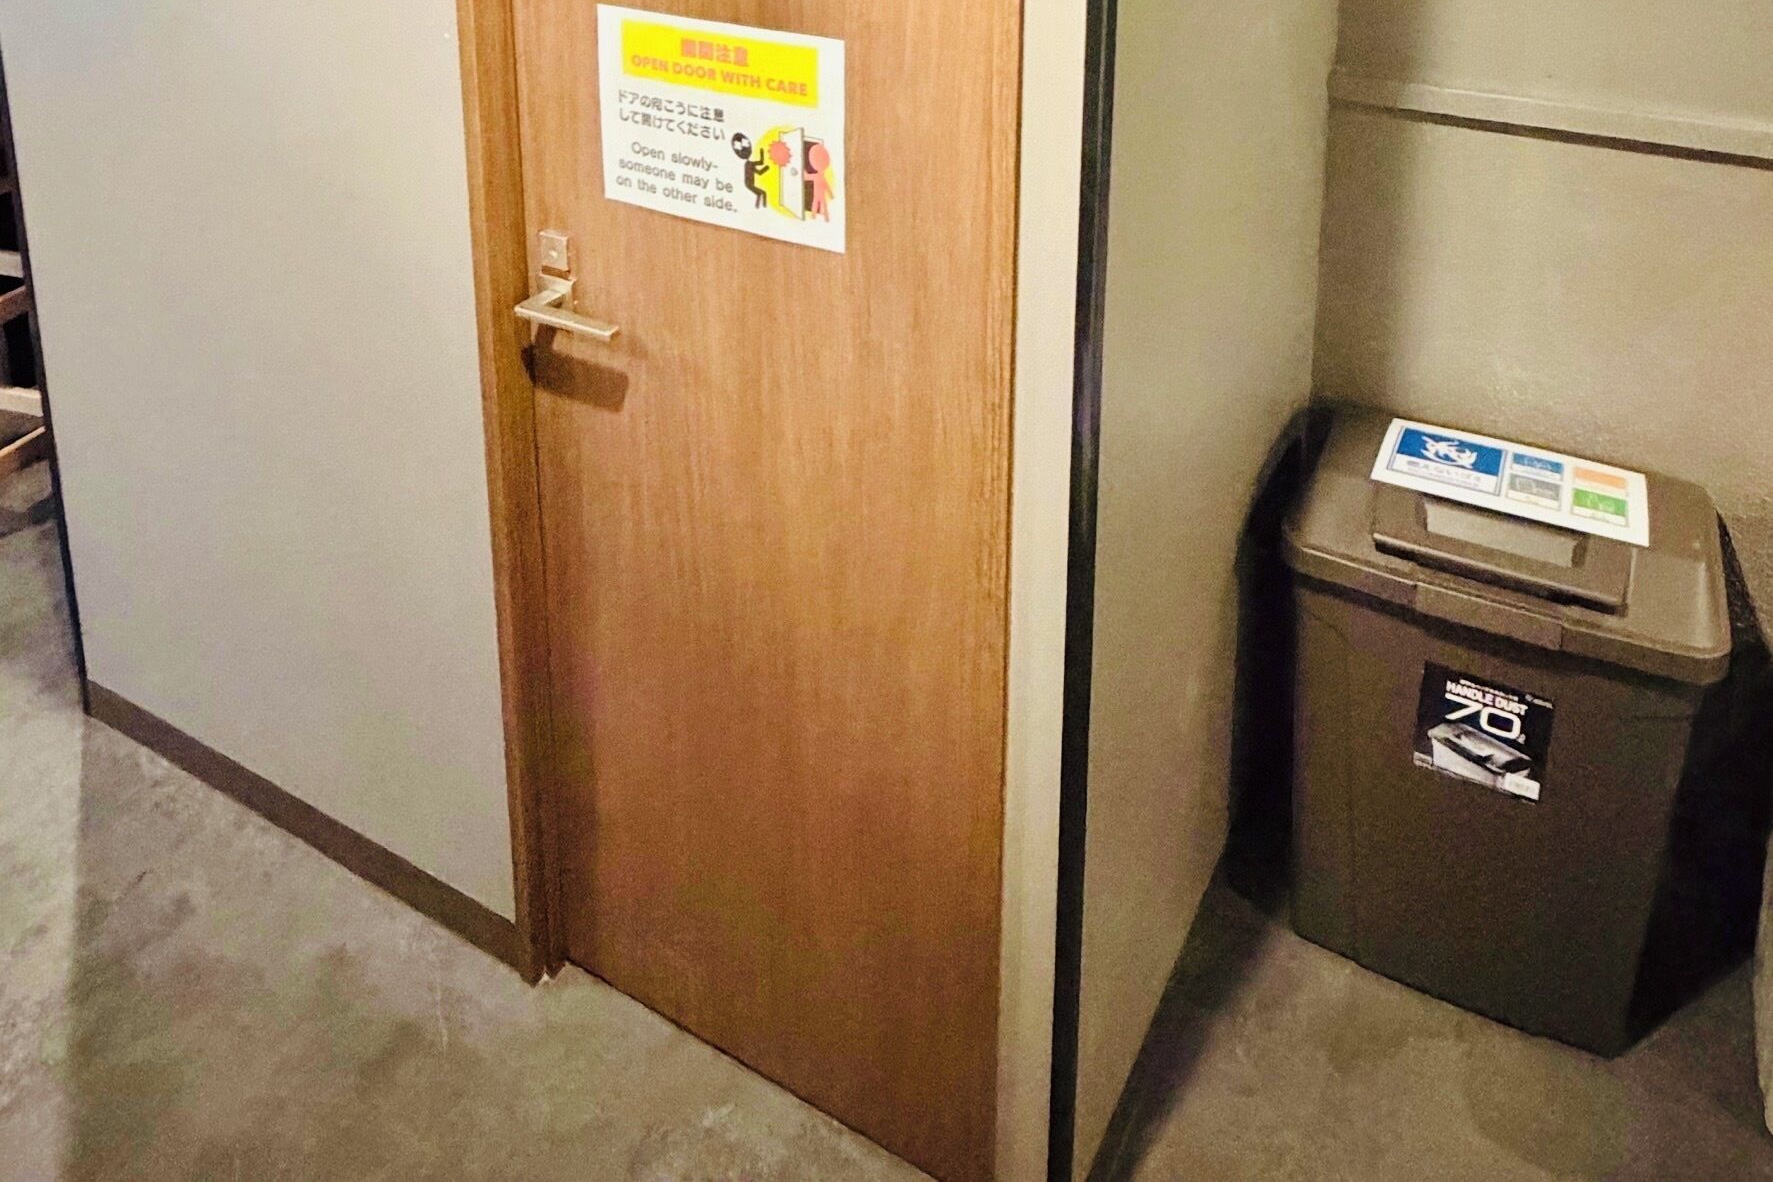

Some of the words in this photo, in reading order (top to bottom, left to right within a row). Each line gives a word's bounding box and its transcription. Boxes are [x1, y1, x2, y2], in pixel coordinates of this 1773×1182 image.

[631, 54, 669, 73] OPEN
[673, 62, 717, 81] DOOR
[721, 70, 761, 89] WITH
[766, 78, 808, 97] CARE
[631, 141, 665, 160] Open
[616, 175, 633, 187] on
[637, 179, 657, 194] the
[663, 186, 698, 204] other
[704, 195, 738, 212] side.
[619, 158, 676, 181] someone
[682, 173, 709, 190] may
[715, 177, 733, 193] be
[1445, 680, 1494, 706] HANDLE
[1495, 696, 1528, 716] DUST
